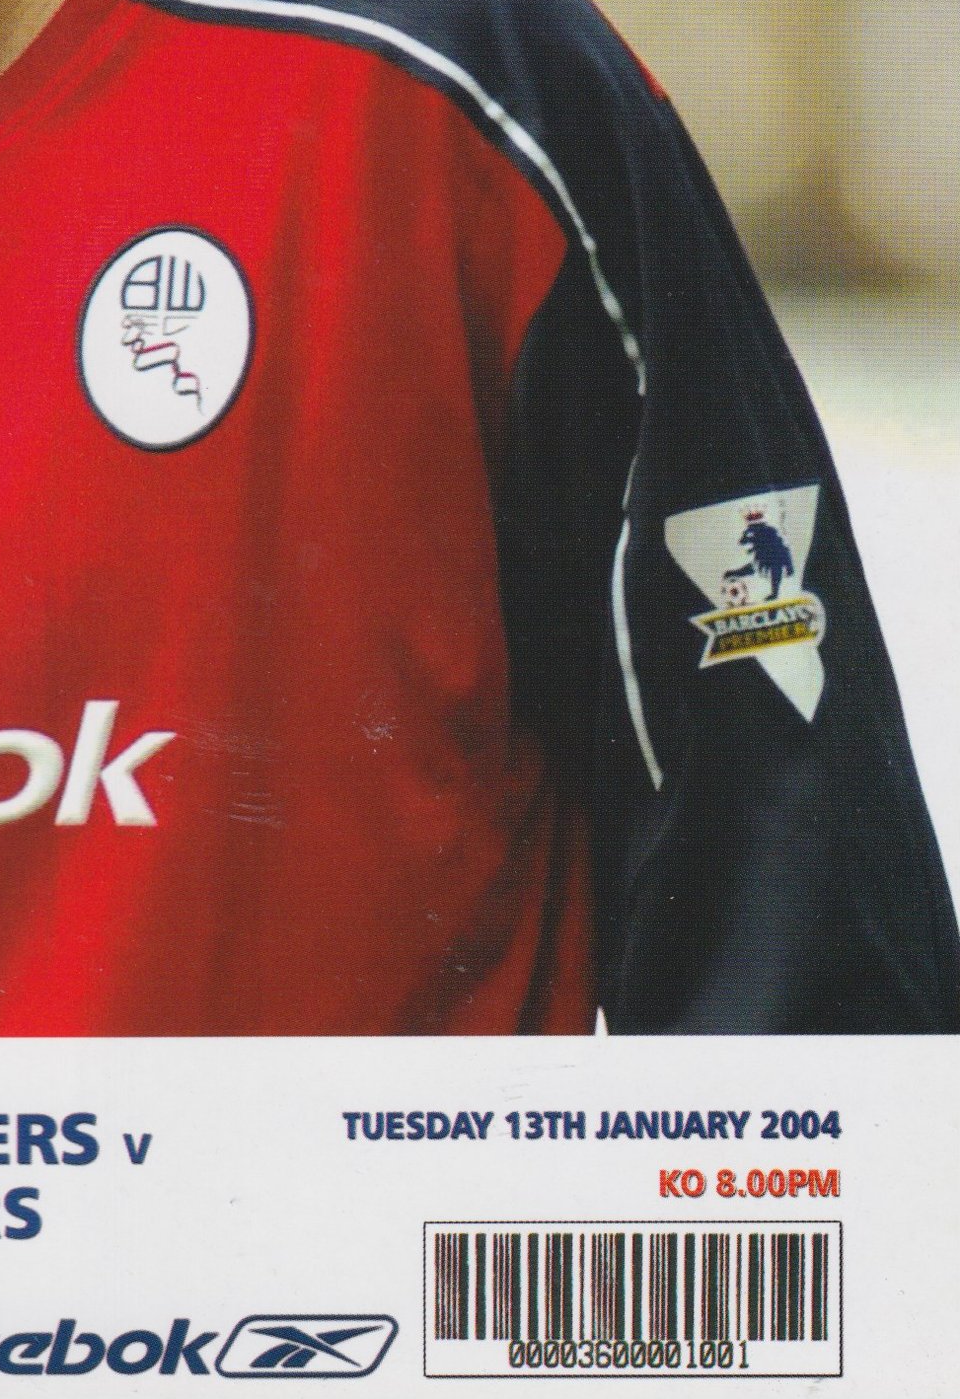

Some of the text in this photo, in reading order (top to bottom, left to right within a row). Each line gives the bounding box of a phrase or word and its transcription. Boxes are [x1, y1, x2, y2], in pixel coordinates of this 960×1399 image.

[342, 1110, 842, 1141] TUESDAY 13TH JANUARY 2004
[122, 1132, 153, 1166] v
[659, 1168, 841, 1198] KO 8.00PM
[508, 1340, 750, 1369] 00003600001001
